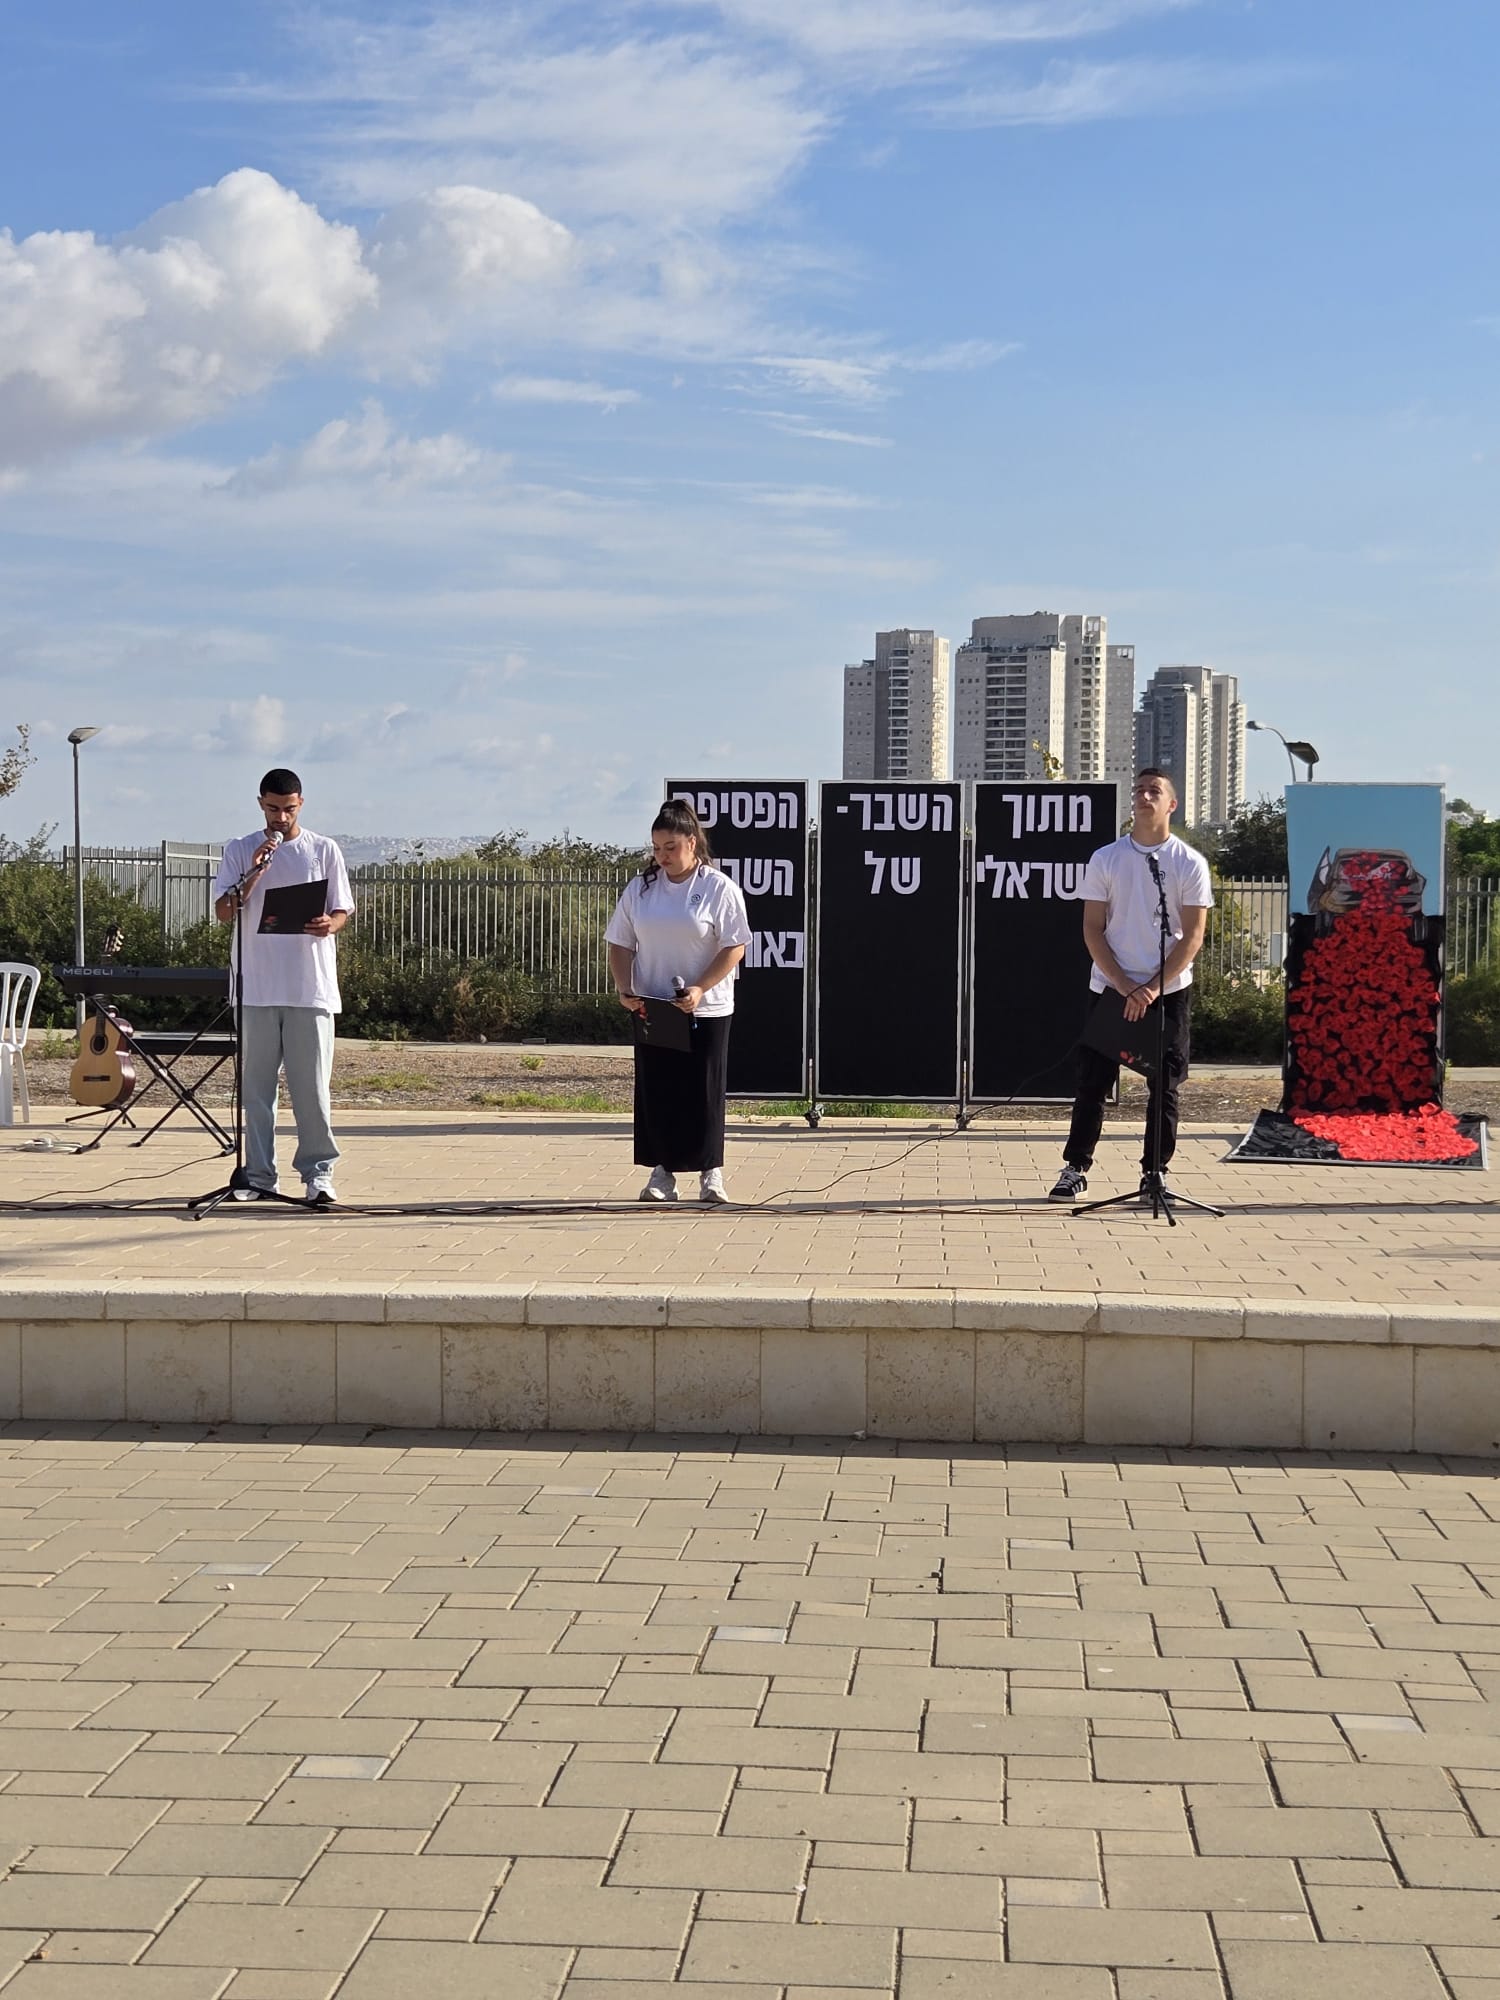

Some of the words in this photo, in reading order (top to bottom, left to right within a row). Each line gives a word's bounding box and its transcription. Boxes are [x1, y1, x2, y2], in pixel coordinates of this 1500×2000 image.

[836, 793, 953, 832] השבר-
[1001, 794, 1092, 839] מתוך
[864, 850, 921, 895] של
[62, 968, 113, 976] MEDELI
